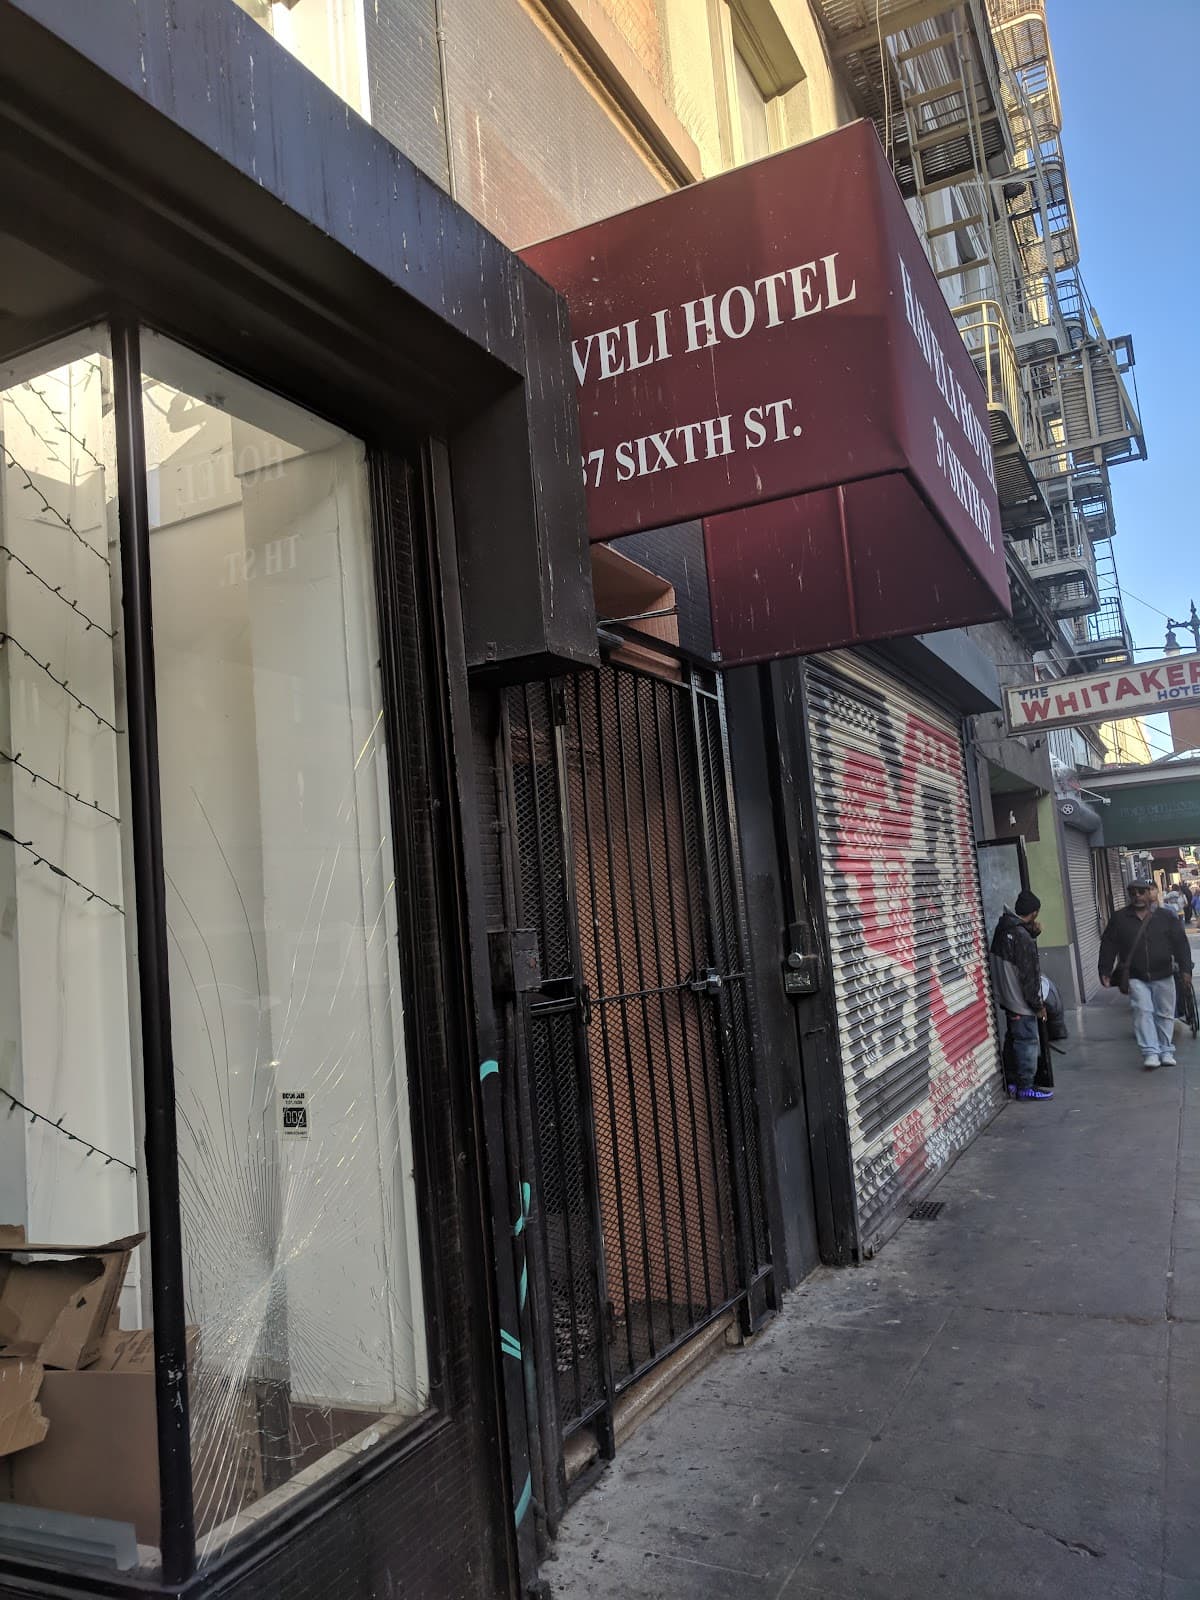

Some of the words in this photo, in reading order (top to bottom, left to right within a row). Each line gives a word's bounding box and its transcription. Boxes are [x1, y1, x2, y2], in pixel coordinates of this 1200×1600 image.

[681, 252, 857, 354] HOTEL
[898, 252, 961, 424] HAVELI
[956, 379, 998, 495] HOTEL
[615, 414, 736, 482] SIXTH
[744, 398, 803, 450] ST.
[933, 416, 947, 478] 37
[946, 440, 983, 534] SIXTH
[980, 498, 996, 554] ST.
[1017, 685, 1050, 702] THE
